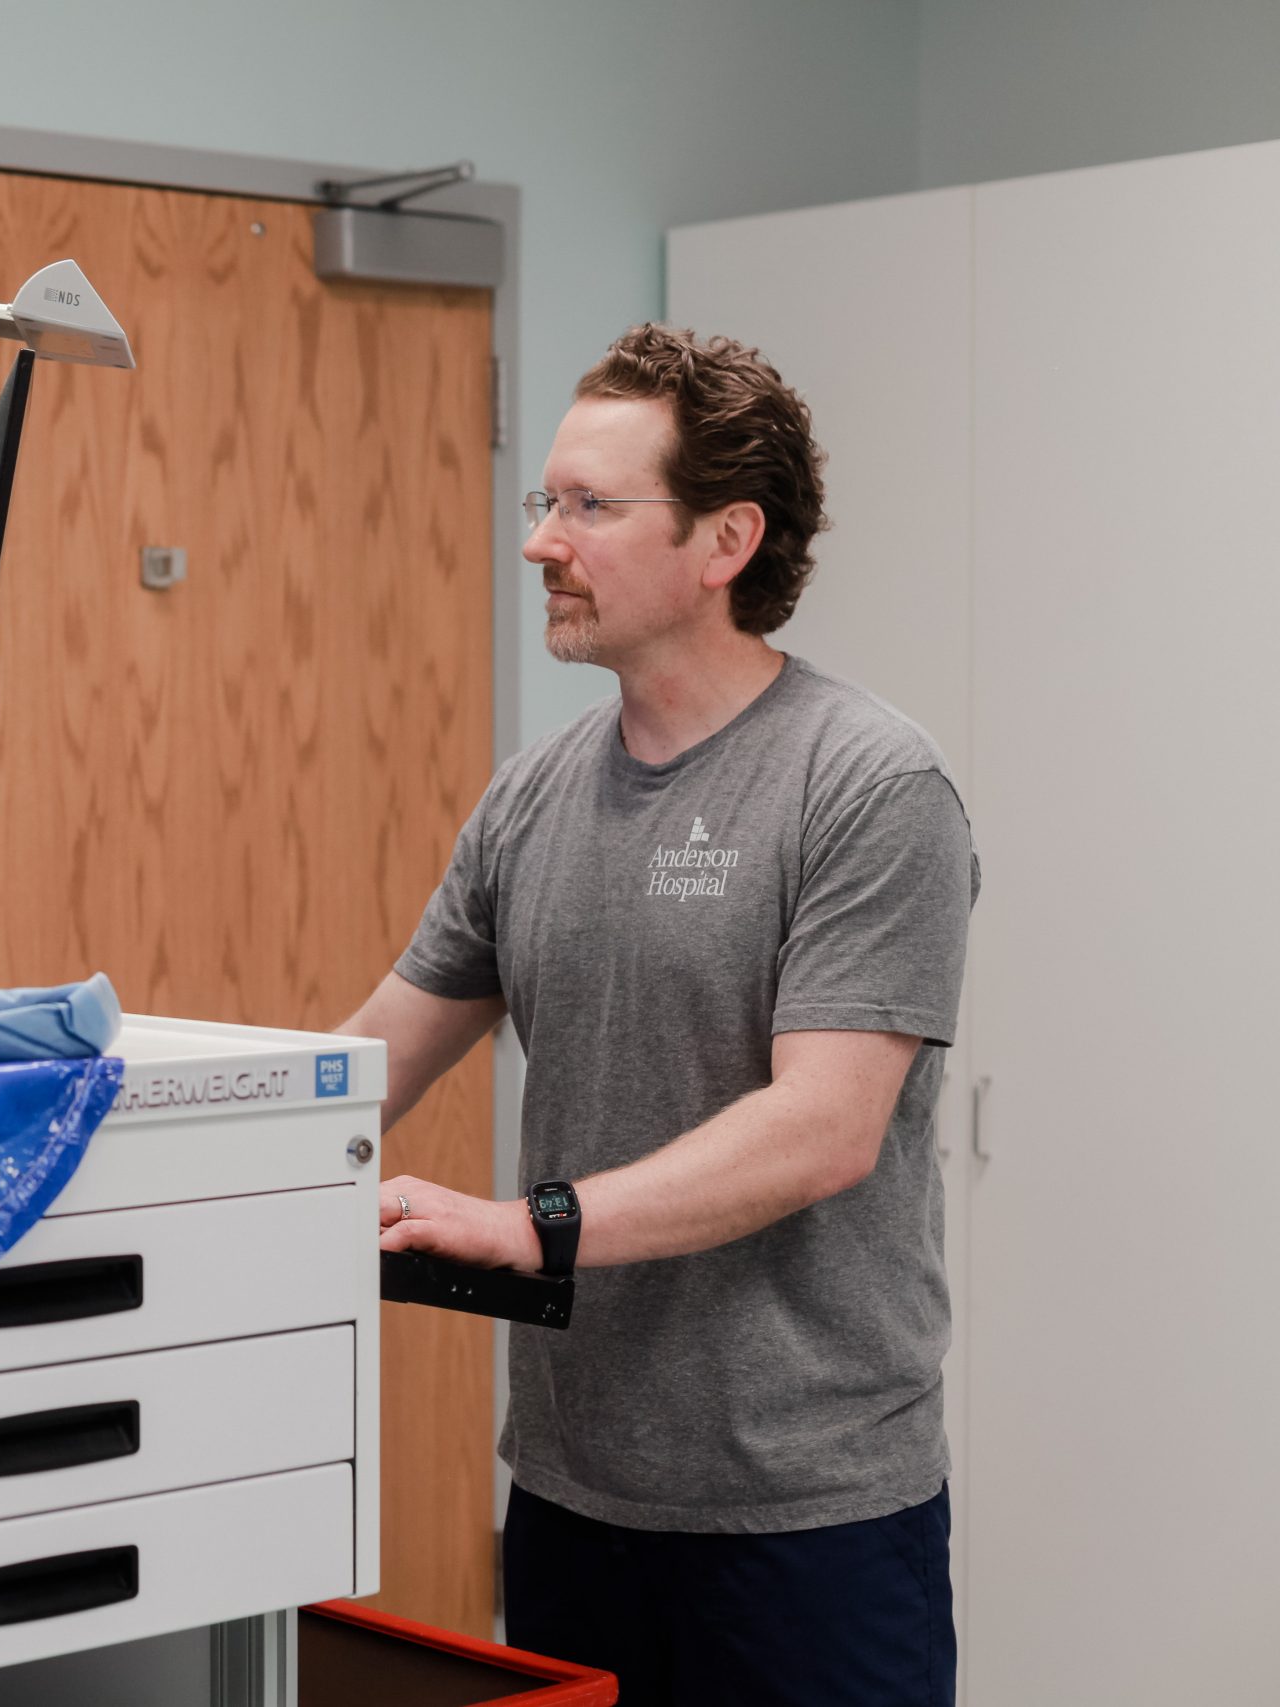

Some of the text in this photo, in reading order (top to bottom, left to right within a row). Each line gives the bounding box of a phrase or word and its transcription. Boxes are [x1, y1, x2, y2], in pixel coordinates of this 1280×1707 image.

[58, 290, 81, 307] NDS
[647, 842, 739, 868] Anderson
[647, 870, 728, 902] Hospital
[320, 1060, 344, 1073] PHS
[320, 1073, 344, 1084] WEST
